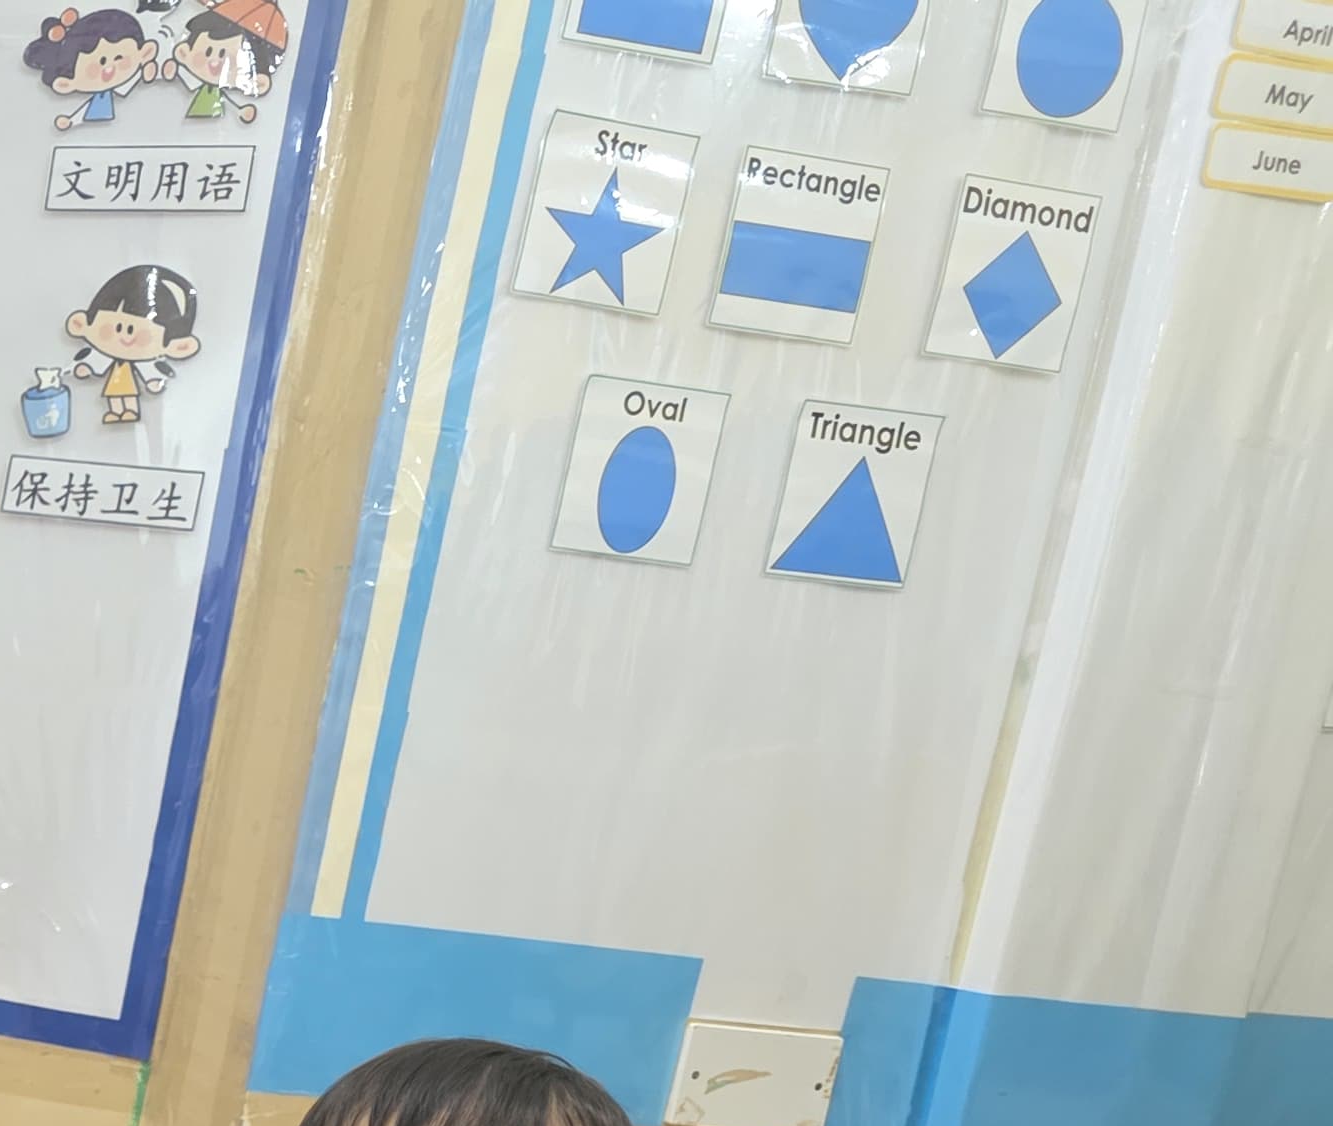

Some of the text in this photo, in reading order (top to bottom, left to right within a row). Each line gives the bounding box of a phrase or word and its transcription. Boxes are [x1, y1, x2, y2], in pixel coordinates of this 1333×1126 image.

[1282, 19, 1333, 47] April
[1264, 84, 1314, 114] May
[594, 129, 650, 162] Star
[1251, 150, 1302, 175] June
[55, 160, 241, 203] 文明用语
[746, 156, 882, 205] Rectangle
[962, 185, 1095, 235] Diamond
[623, 391, 688, 424] Oval
[808, 412, 922, 455] Triangle
[11, 469, 187, 522] 保持卫生
